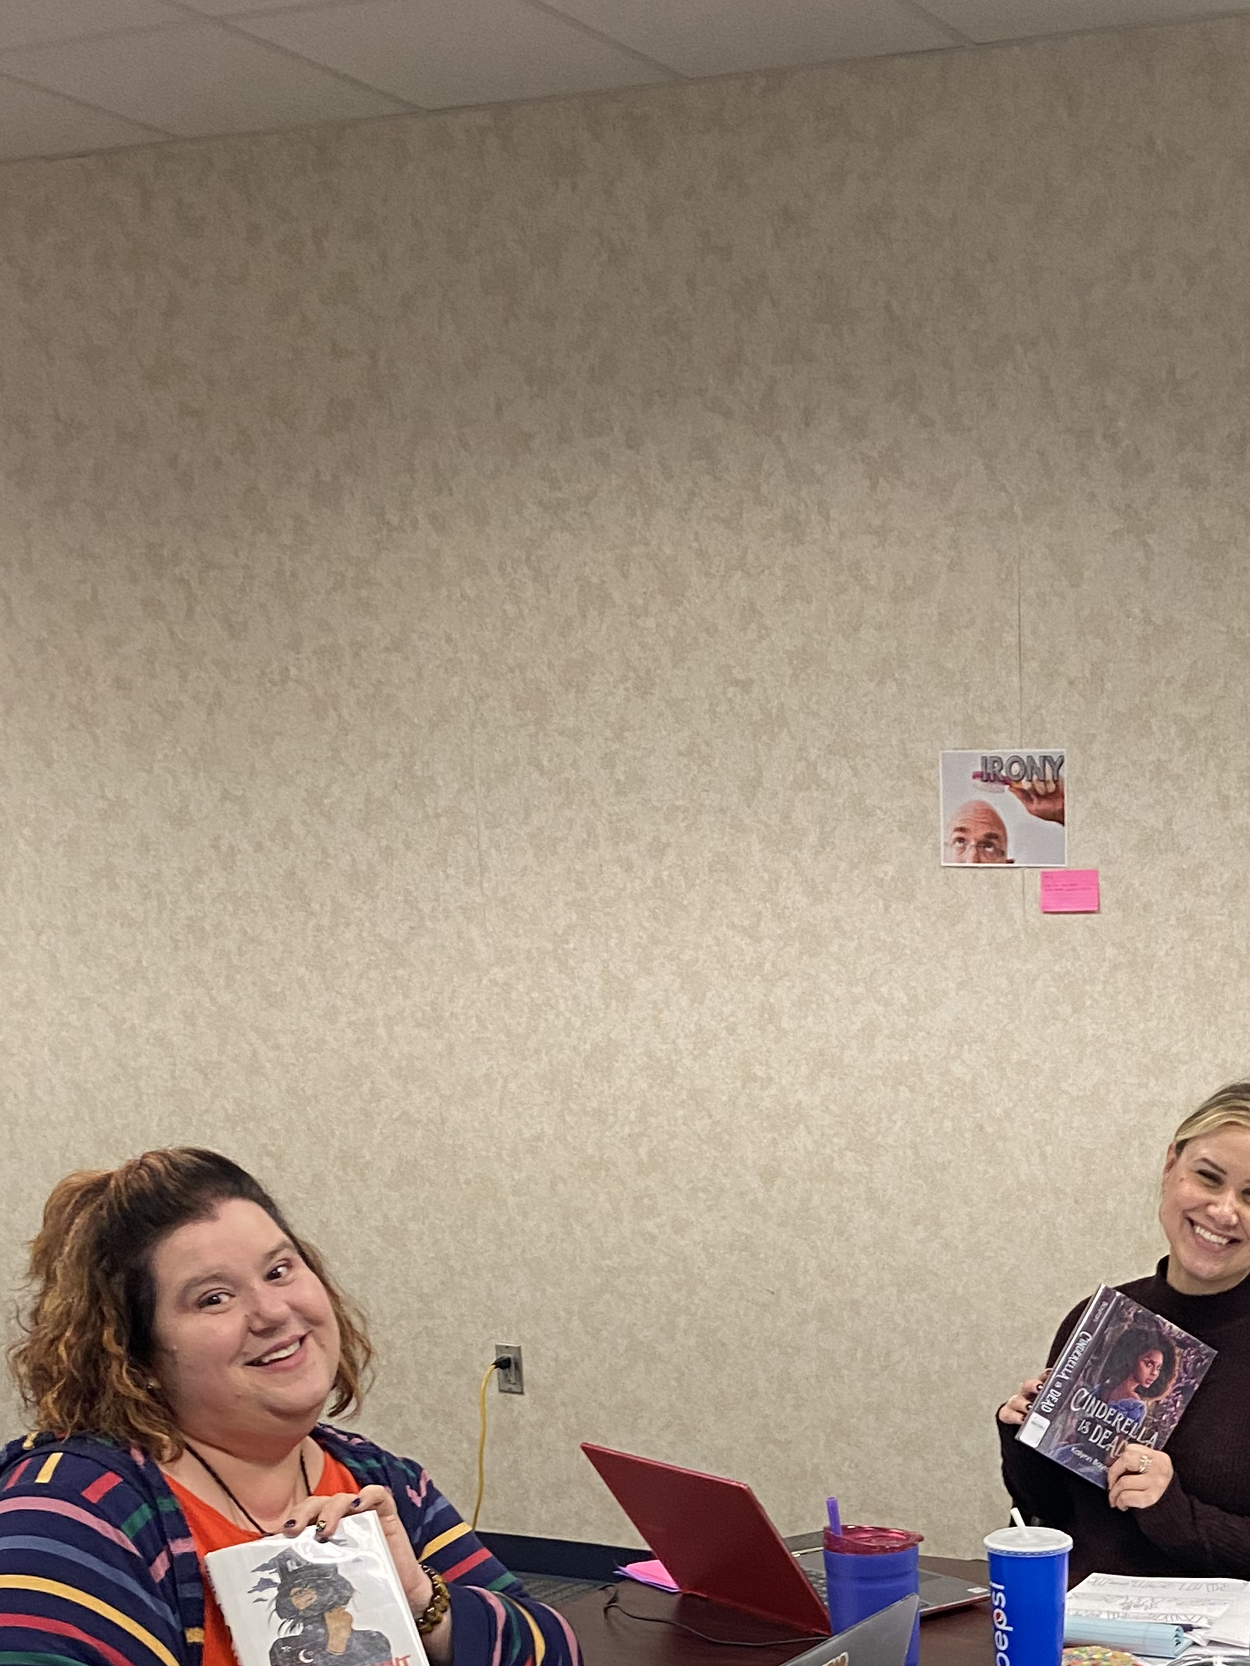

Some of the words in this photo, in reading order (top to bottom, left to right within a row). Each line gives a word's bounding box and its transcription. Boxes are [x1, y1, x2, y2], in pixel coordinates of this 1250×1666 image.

[980, 755, 1065, 782] IRONY
[1056, 1331, 1092, 1380] CINDERELLA
[1040, 1388, 1061, 1413] DEAD
[1070, 1387, 1159, 1449] CINDERELLA
